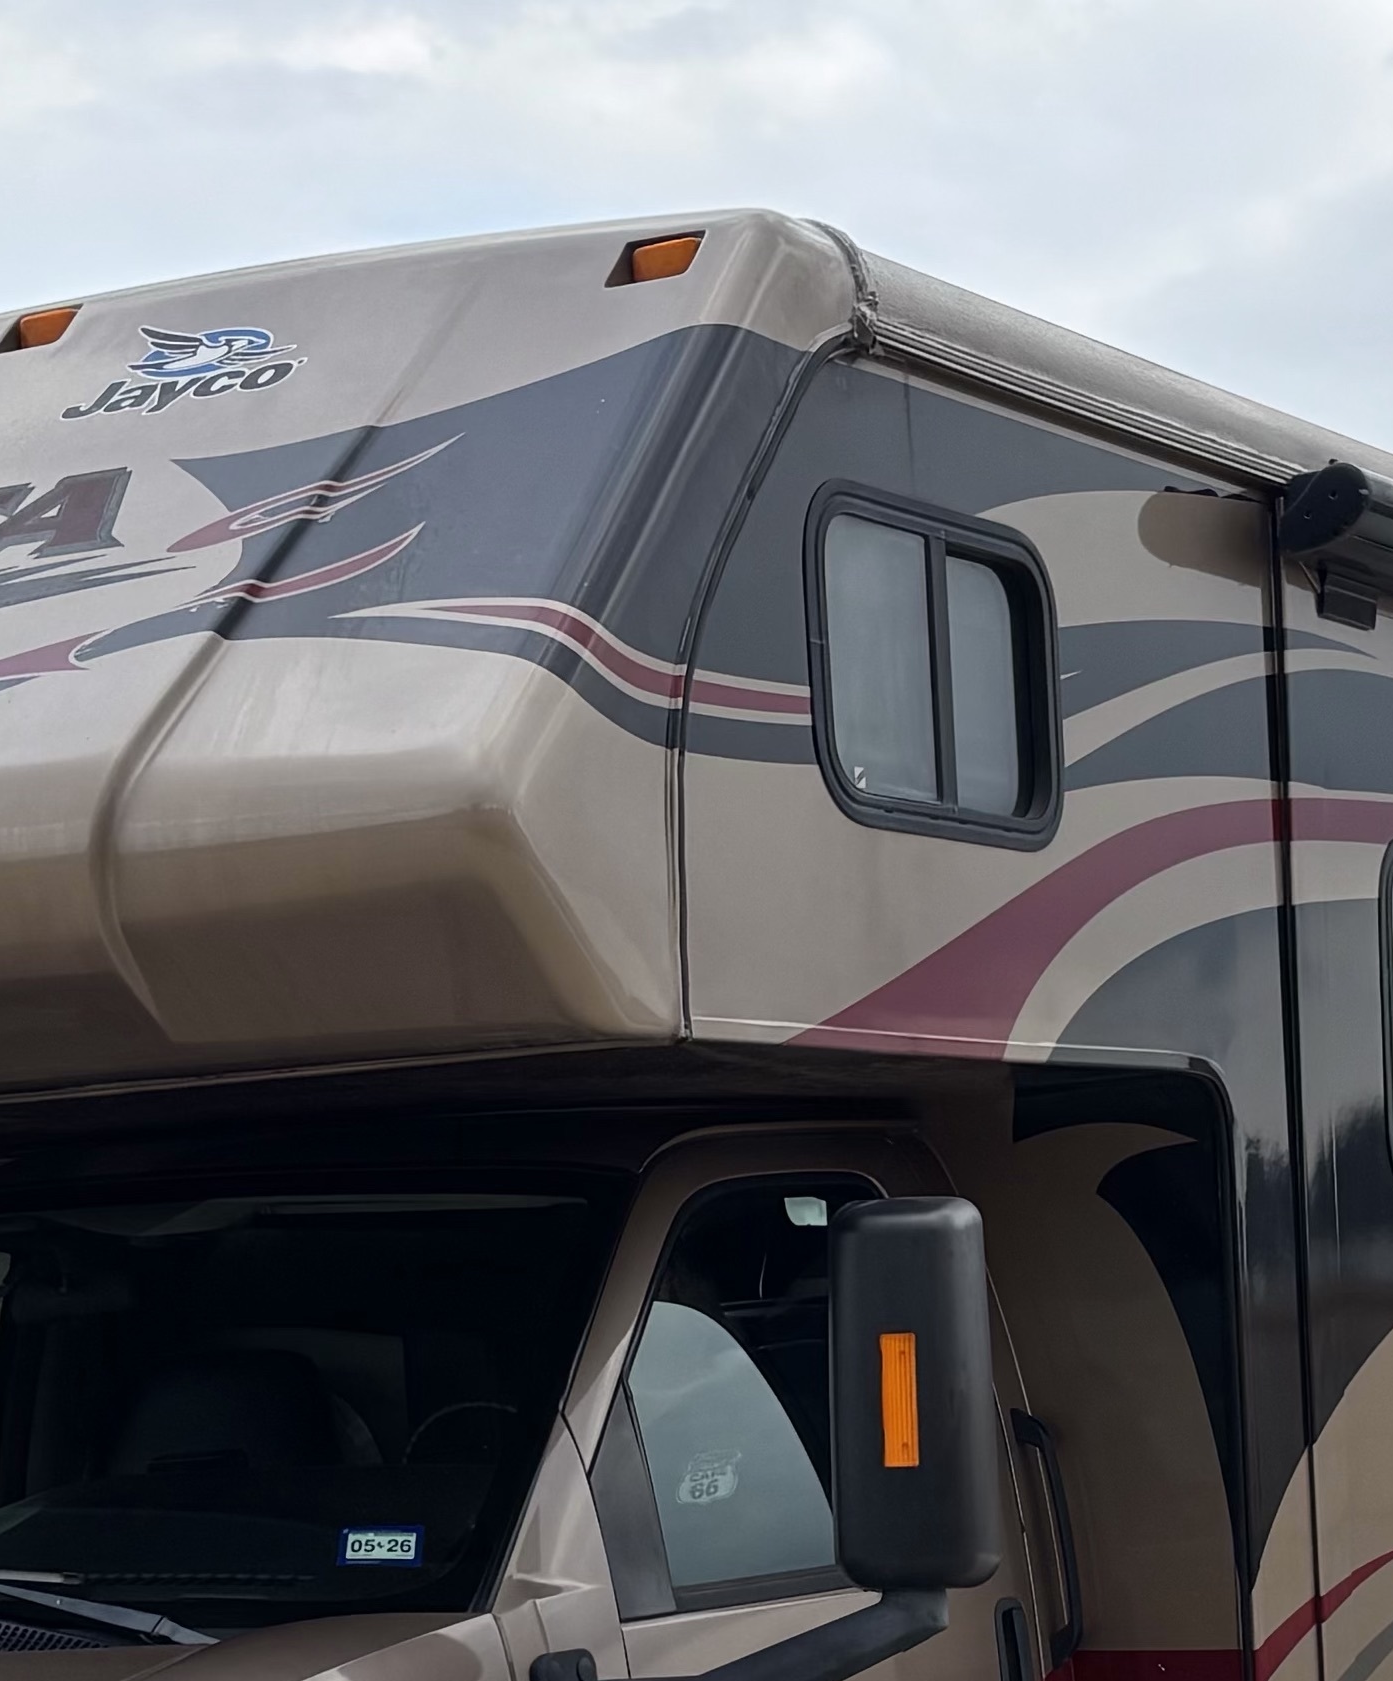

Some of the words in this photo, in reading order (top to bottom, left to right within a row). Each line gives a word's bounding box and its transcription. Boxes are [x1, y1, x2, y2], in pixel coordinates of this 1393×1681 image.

[60, 360, 298, 421] Jayco
[350, 1539, 376, 1553] 05
[386, 1538, 412, 1553] 26
